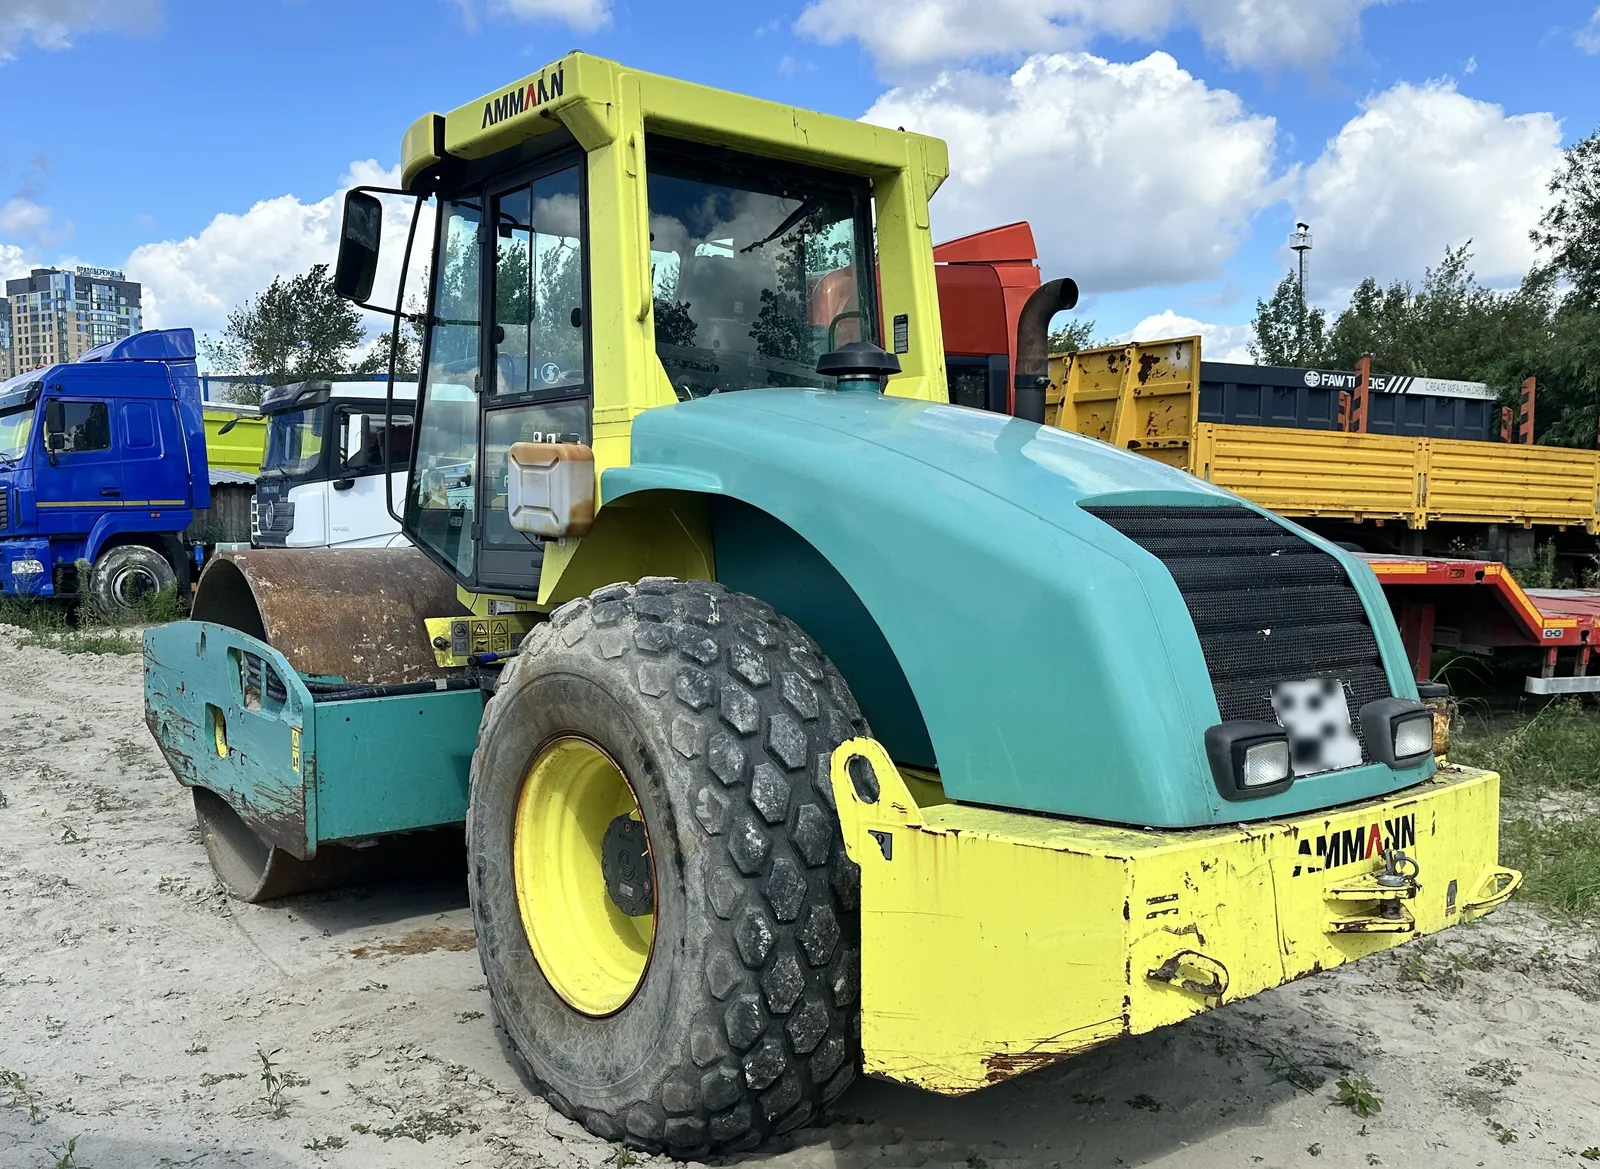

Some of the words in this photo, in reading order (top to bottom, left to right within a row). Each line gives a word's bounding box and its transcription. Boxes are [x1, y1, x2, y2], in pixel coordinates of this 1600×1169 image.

[481, 63, 564, 130] AMMANN
[1321, 373, 1345, 387] FAW
[1425, 381, 1447, 392] CREATE
[1292, 813, 1415, 878] AMMANN
